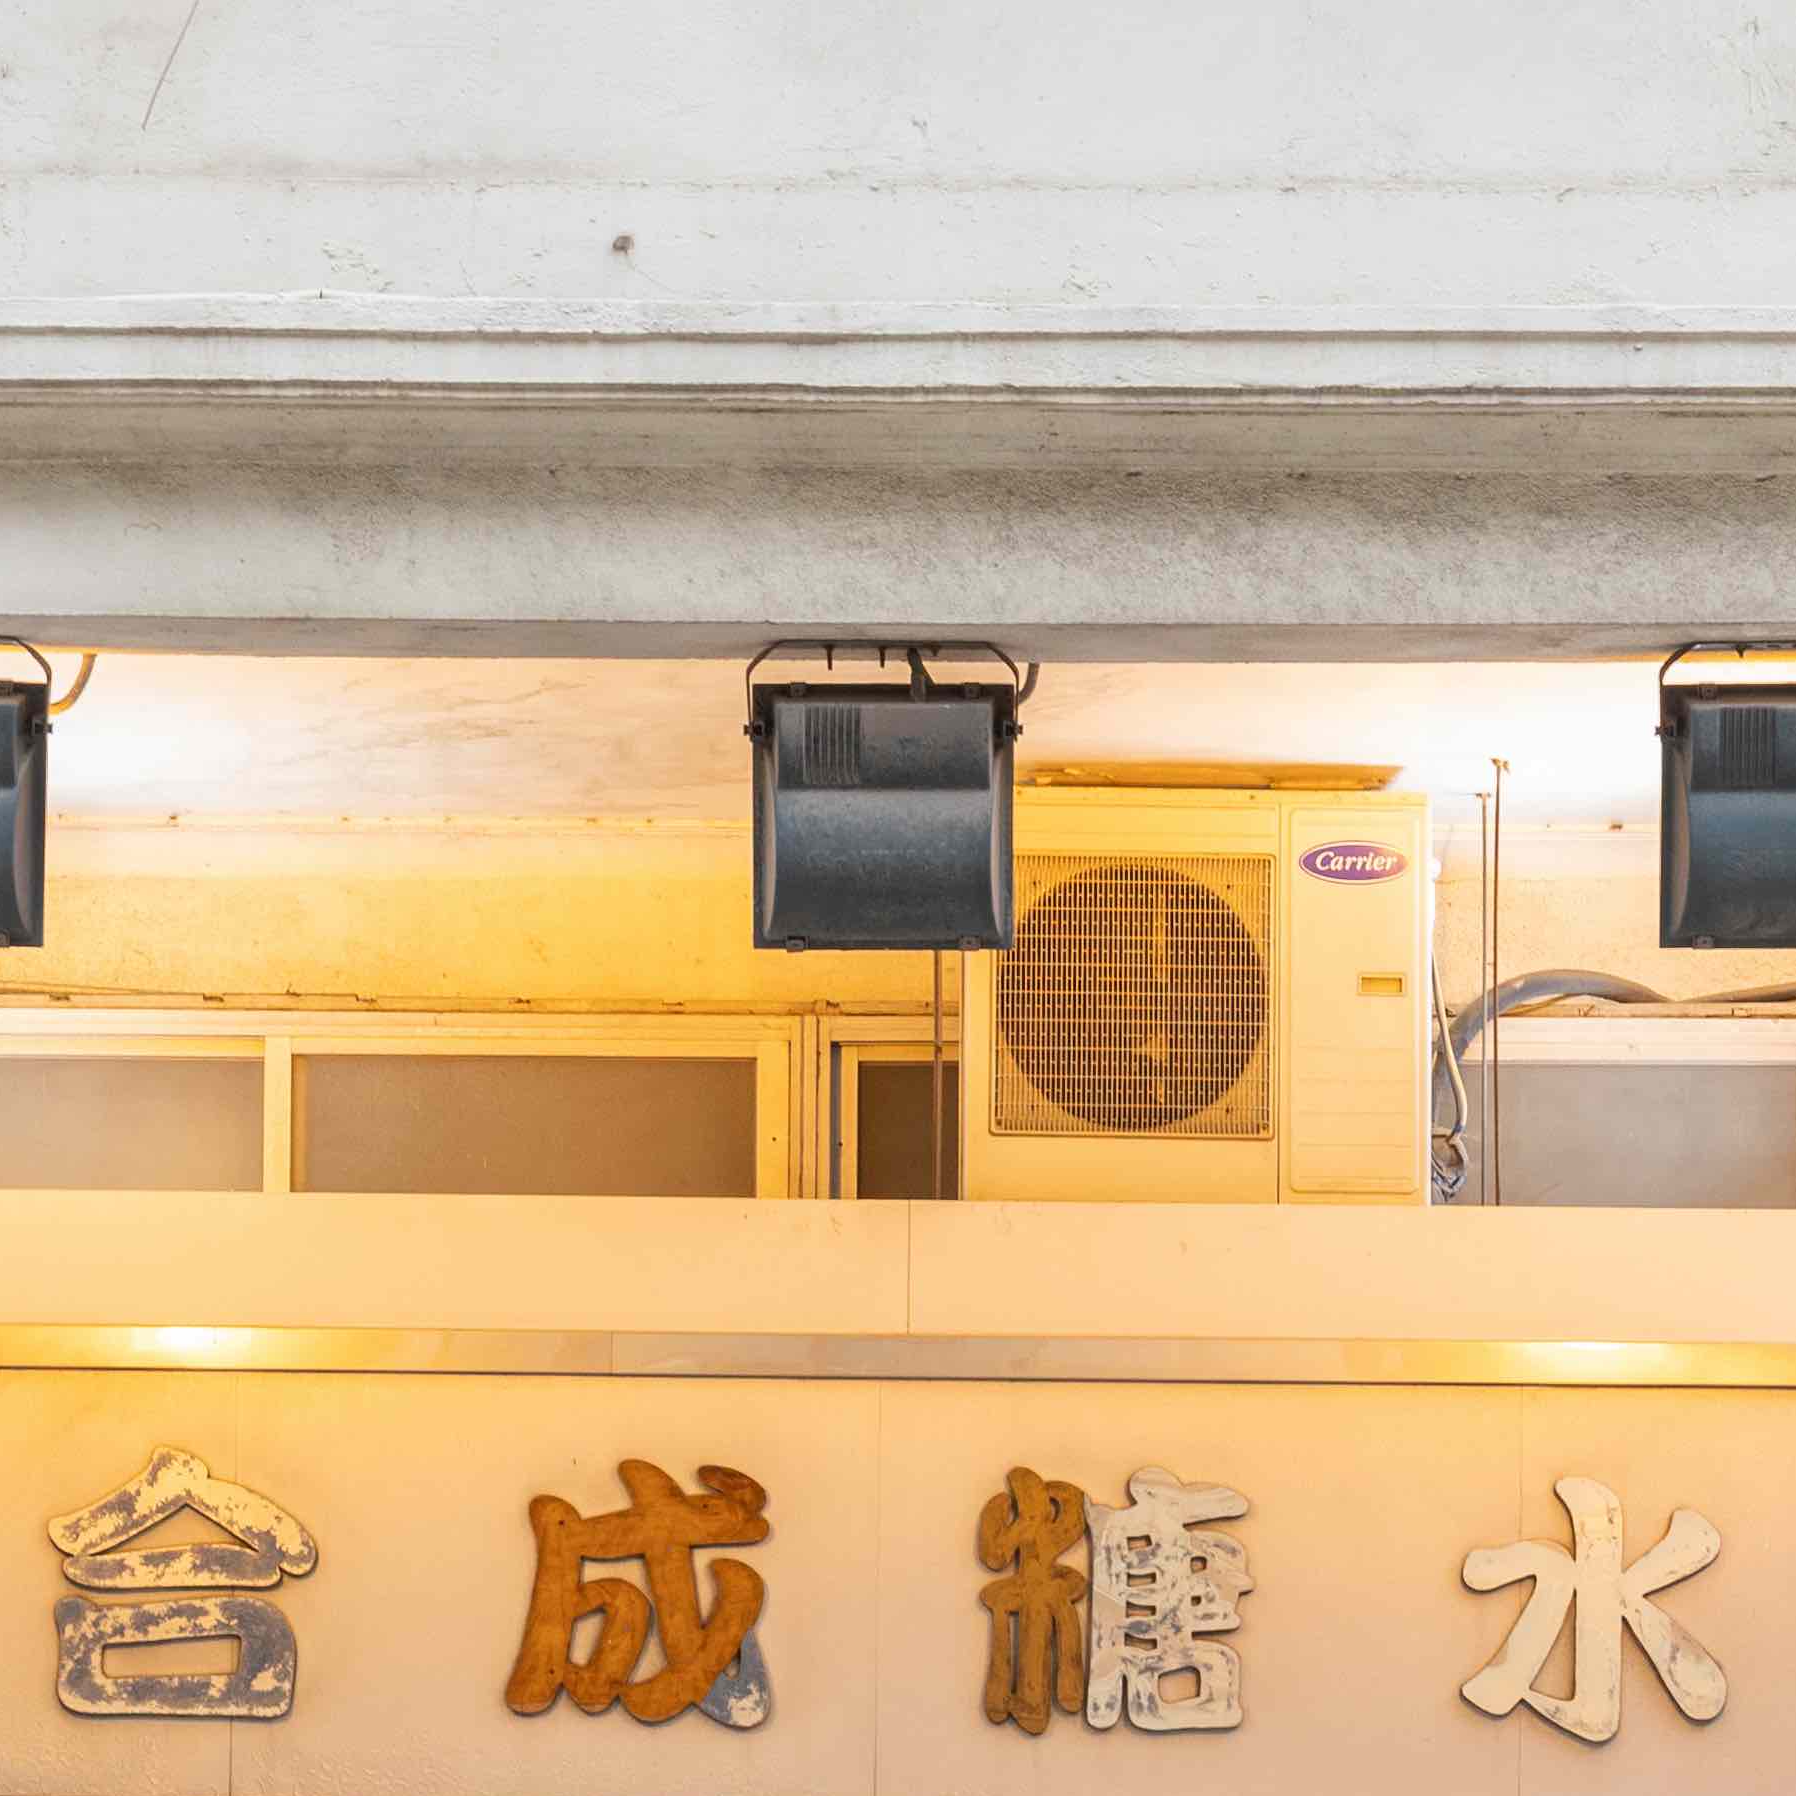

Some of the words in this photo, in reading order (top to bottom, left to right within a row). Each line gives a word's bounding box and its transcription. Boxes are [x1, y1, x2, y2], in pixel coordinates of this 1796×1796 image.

[1314, 849, 1400, 874] Carrier
[48, 1445, 1727, 1744] 合成糖水
